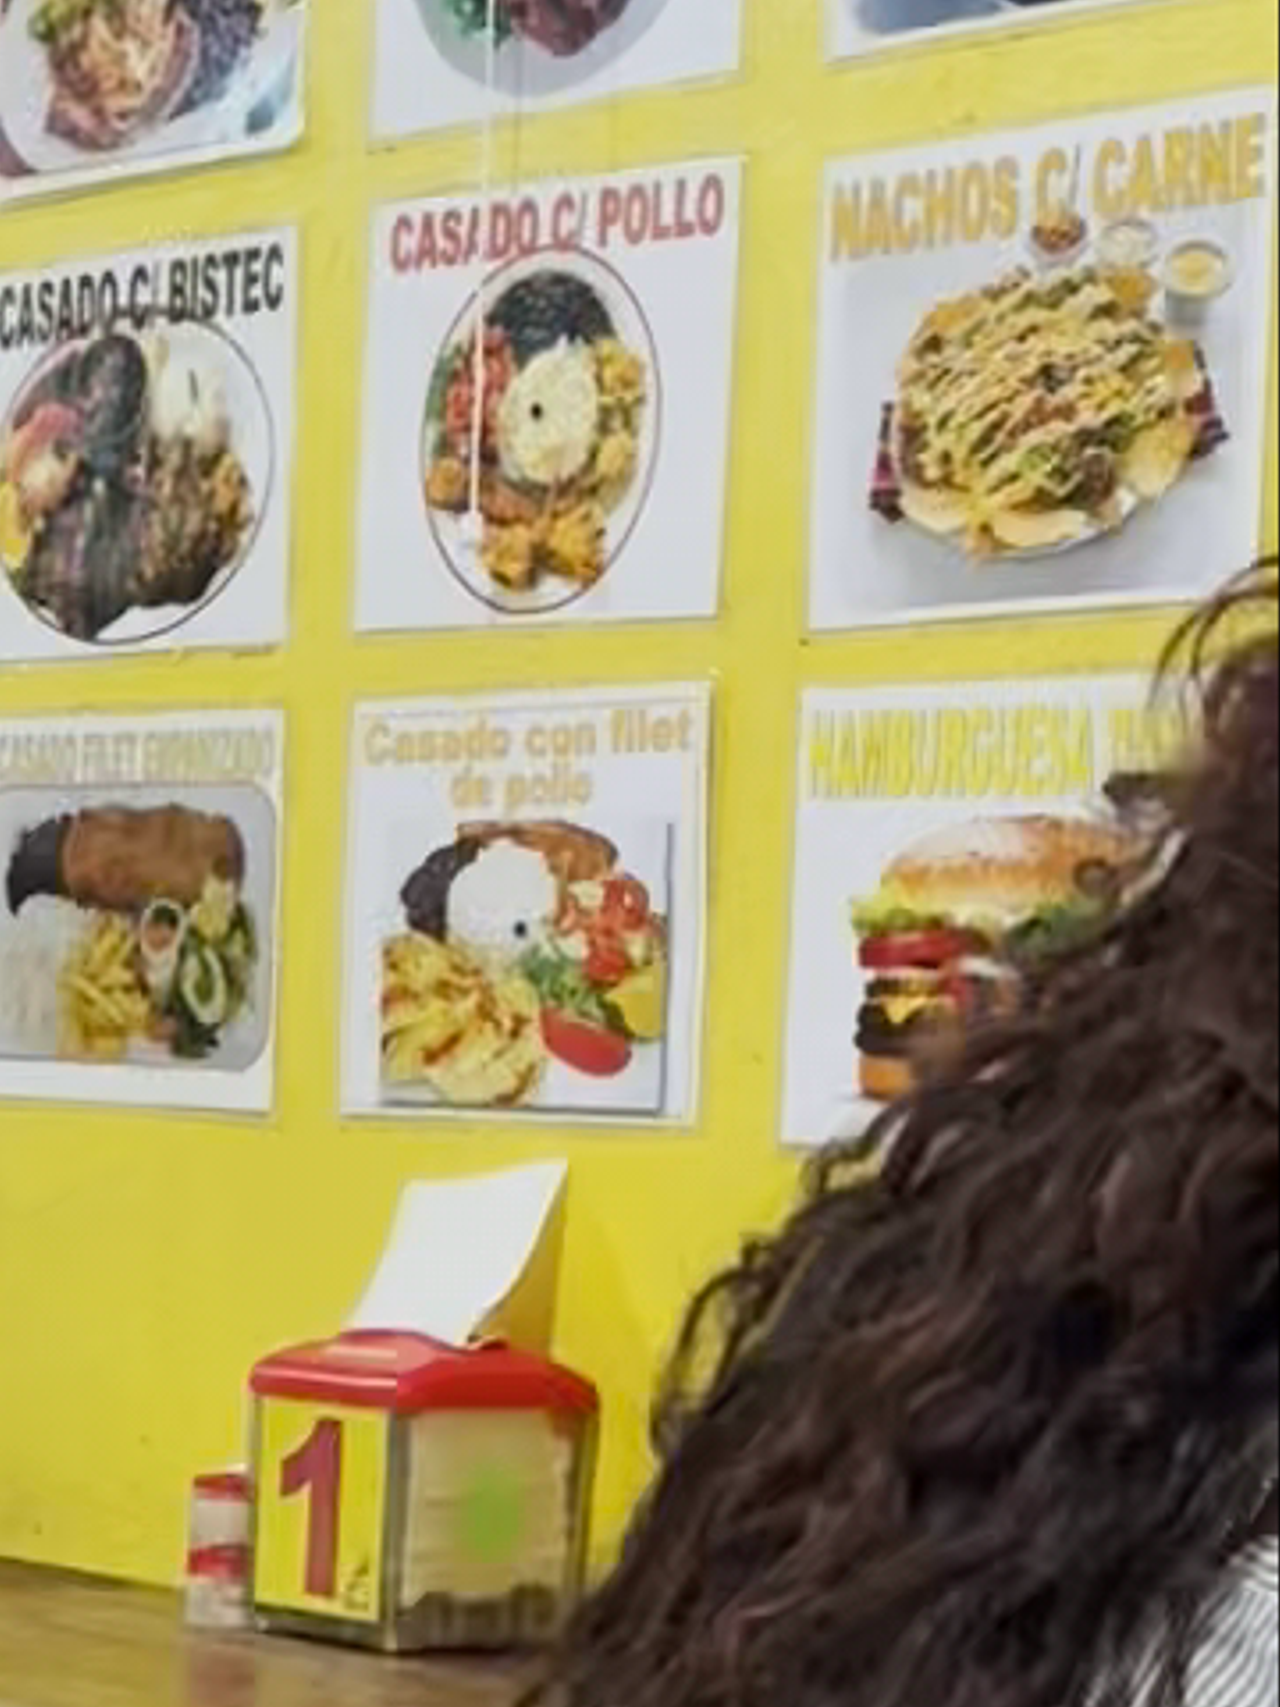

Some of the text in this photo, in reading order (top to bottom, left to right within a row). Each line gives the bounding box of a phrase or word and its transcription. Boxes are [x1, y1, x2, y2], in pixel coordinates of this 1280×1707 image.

[391, 198, 540, 273] CASADO
[597, 173, 725, 248] POLLO
[828, 154, 1020, 264] NACHOS
[1093, 111, 1267, 221] CARNE
[168, 241, 285, 324] BISTEC
[363, 713, 512, 766] Casado
[524, 721, 597, 759] con
